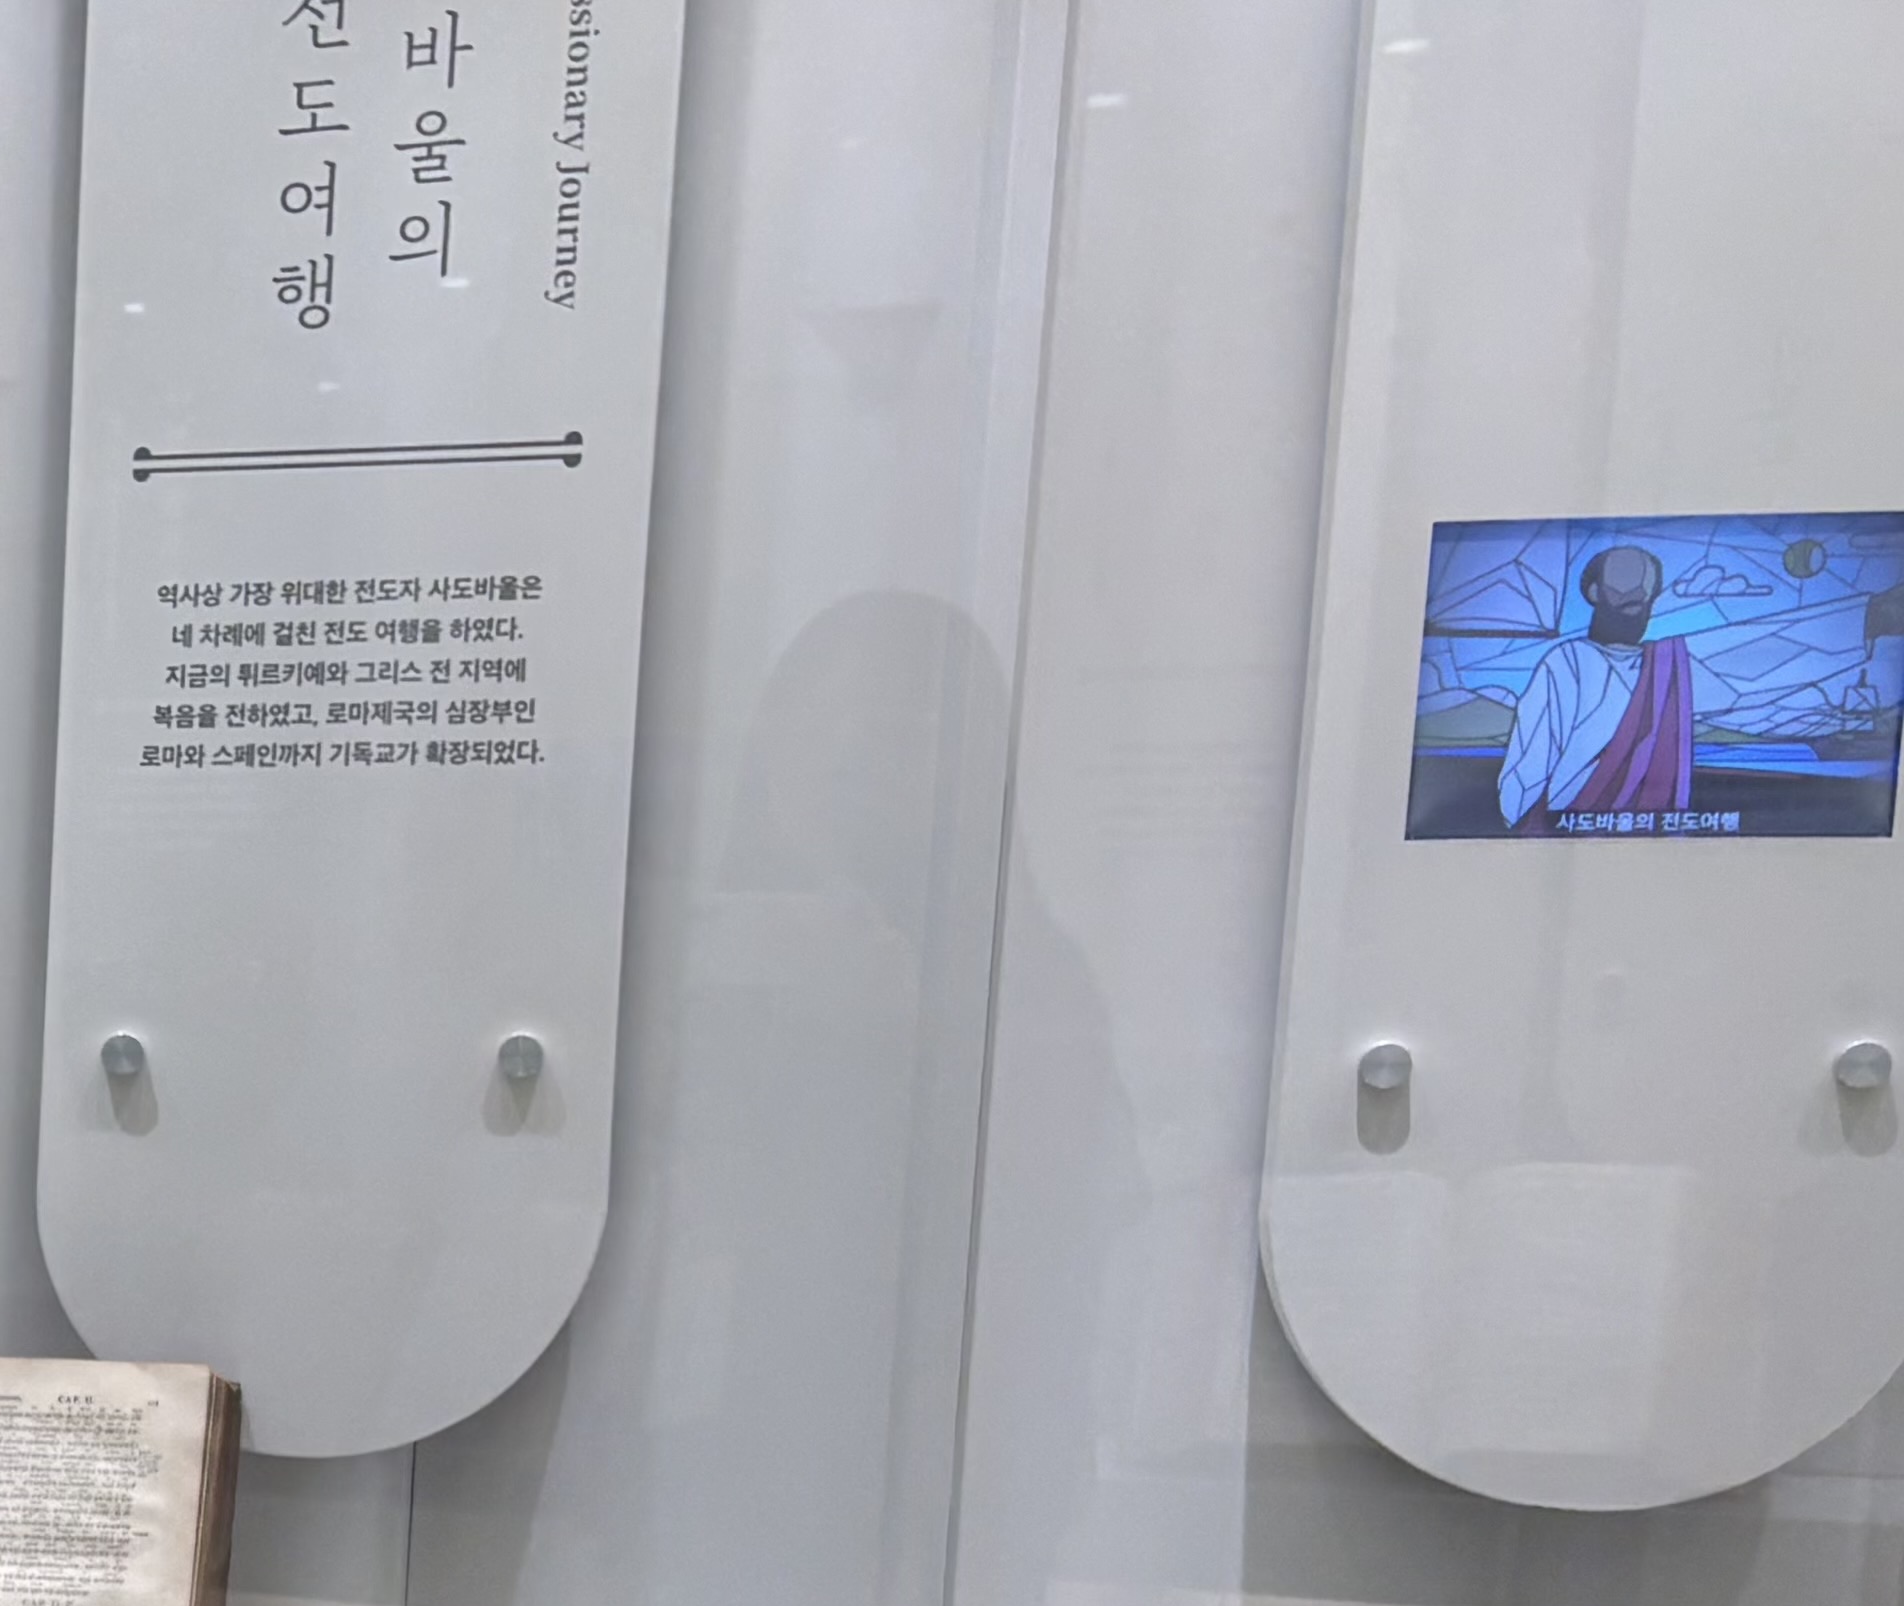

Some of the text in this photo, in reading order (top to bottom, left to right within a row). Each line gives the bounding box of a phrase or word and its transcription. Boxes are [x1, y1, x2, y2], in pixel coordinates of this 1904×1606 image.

[388, 9, 475, 278] 바울의
[272, 0, 351, 330] 전도여행
[544, 160, 591, 310] Journey
[157, 575, 542, 609] 역사상 가장 위대한 전도자 사도바울은
[172, 616, 523, 648] 네 차례에 걸친 전도 여행을 하였다.
[165, 657, 526, 688] 지금의 튀르키예와 그리스 전 지역에
[153, 698, 536, 729] 복음을 전하였고, 로마제국의 심장부인
[140, 739, 545, 769] 로마와 스페인까지 기독교가 확장되었다.
[1556, 811, 1740, 832] 사도바울의 전도여행
